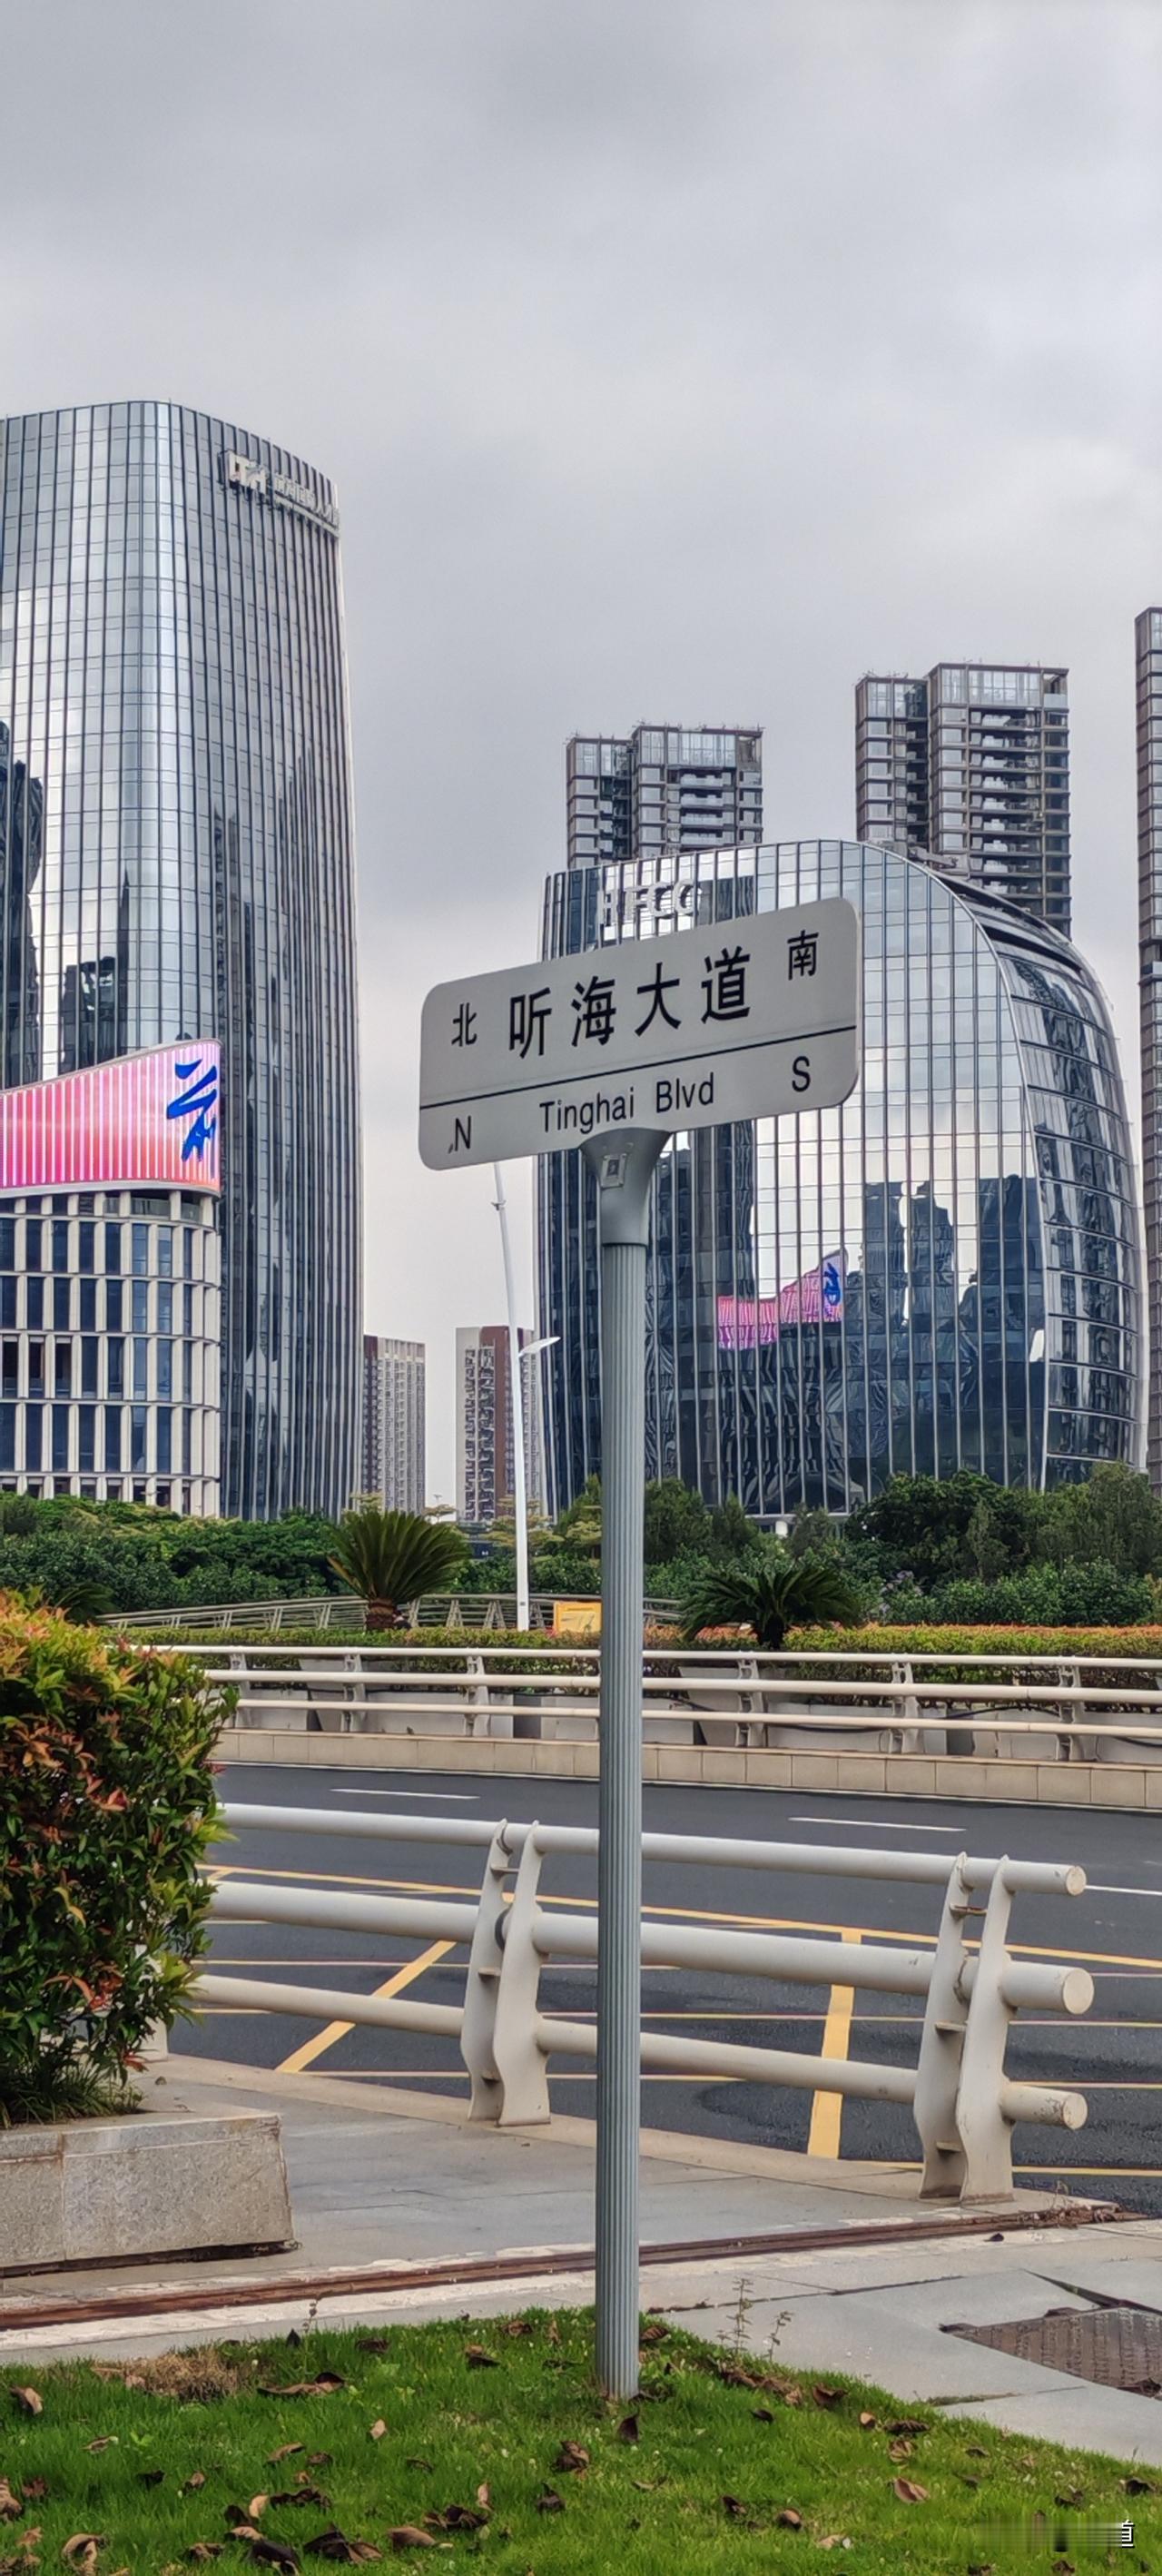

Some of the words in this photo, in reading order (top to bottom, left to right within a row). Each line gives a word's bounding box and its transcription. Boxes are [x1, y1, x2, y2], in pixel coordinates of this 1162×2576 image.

[786, 929, 820, 982] 南
[451, 1002, 478, 1048] 北
[508, 945, 751, 1060] 听海大道
[792, 1055, 812, 1093] S
[539, 1086, 635, 1135] Tinghai
[655, 1071, 715, 1114] Blvd
[453, 1116, 472, 1151] N
